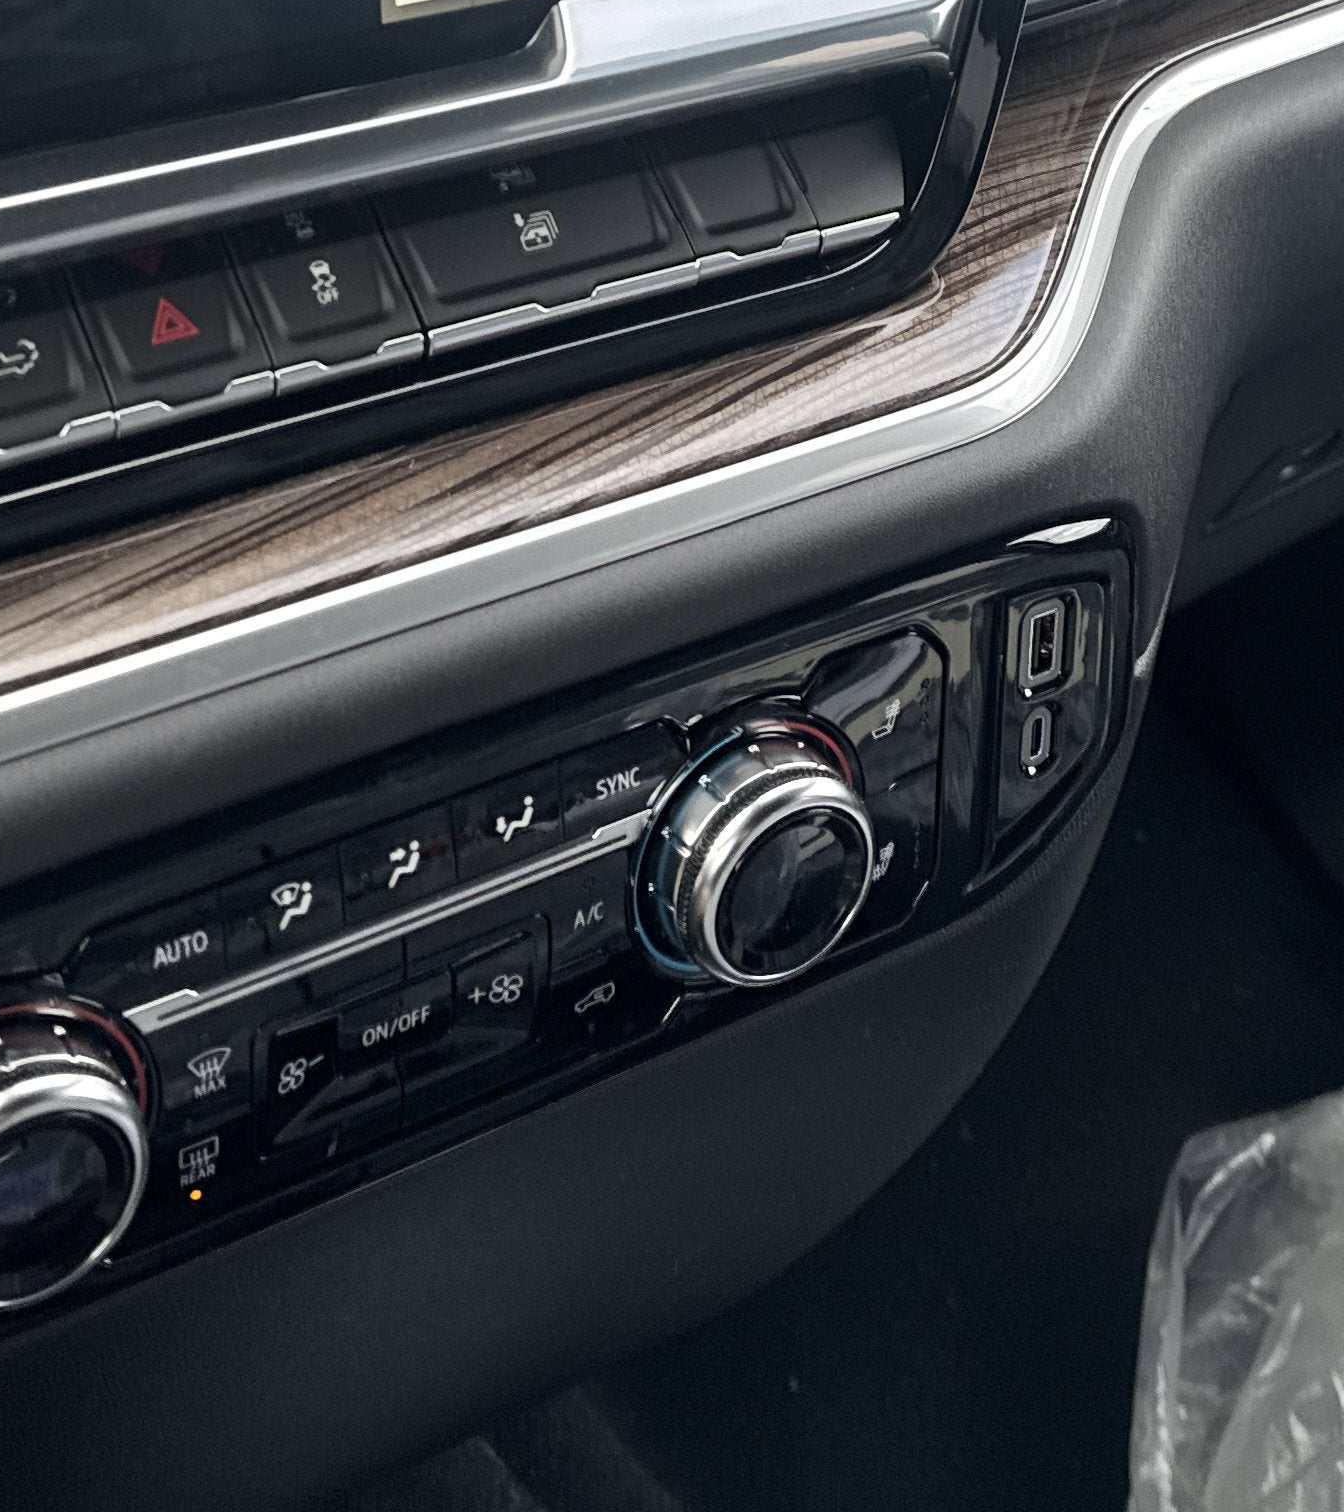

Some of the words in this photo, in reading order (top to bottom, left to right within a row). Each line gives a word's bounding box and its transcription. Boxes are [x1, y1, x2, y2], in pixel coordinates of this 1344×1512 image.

[595, 766, 641, 801] SYNC
[573, 901, 604, 931] A/C
[153, 930, 209, 969] AUTO
[361, 1004, 432, 1048] ON/OFF
[193, 1075, 227, 1100] MAX
[180, 1163, 217, 1187] REAR
